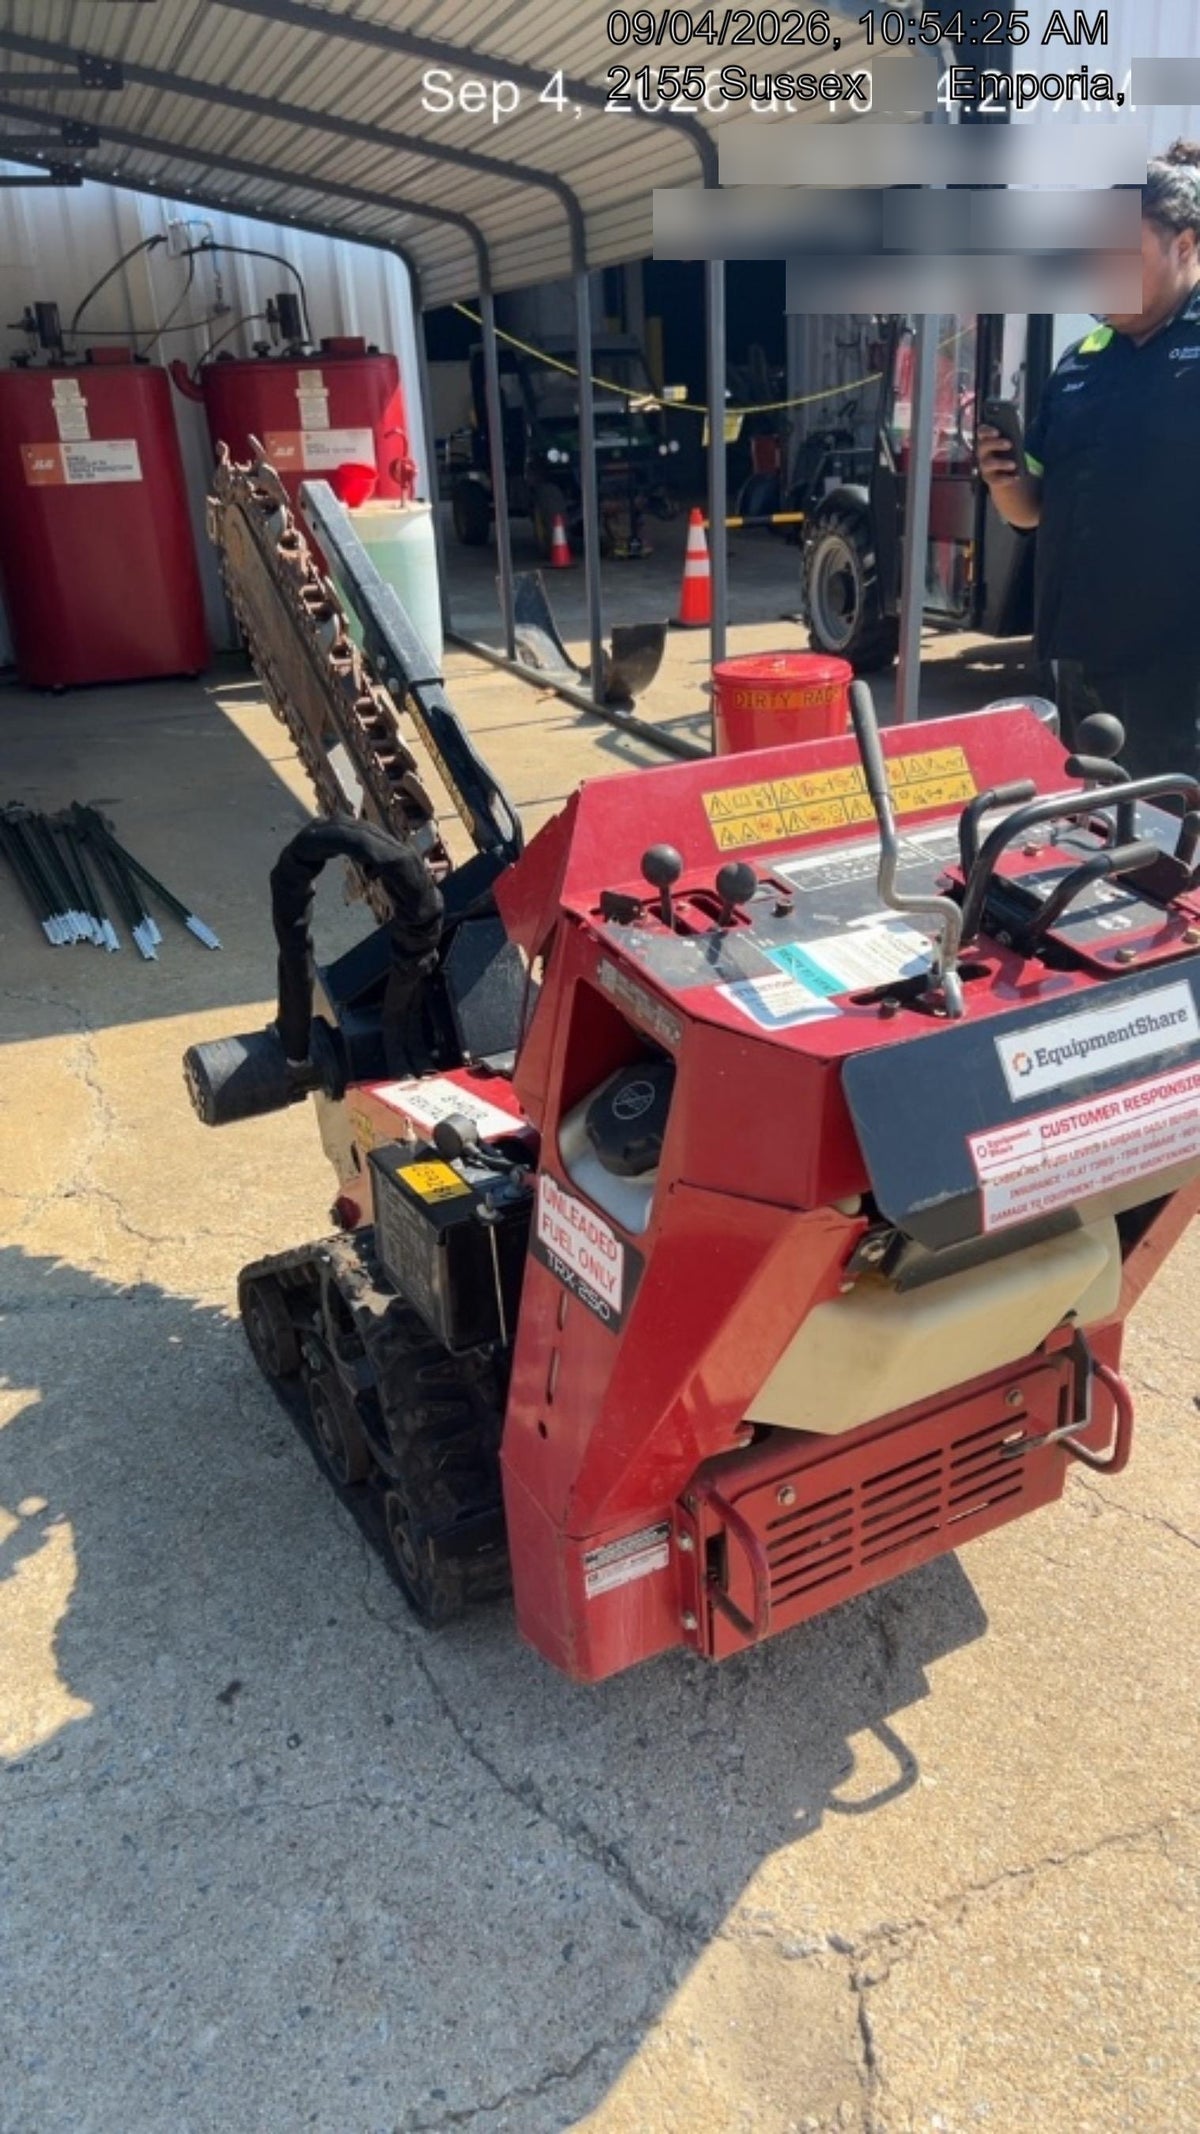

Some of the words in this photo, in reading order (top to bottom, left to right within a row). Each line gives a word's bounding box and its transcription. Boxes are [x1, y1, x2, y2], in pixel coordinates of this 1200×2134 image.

[735, 691, 790, 709] DIRTY
[1034, 1008, 1188, 1068] EquipmentShare
[1040, 1101, 1121, 1139] CUSTOMER
[543, 1180, 617, 1262] UNLEADED
[542, 1212, 574, 1258] FUEL
[578, 1247, 617, 1294] ONLY
